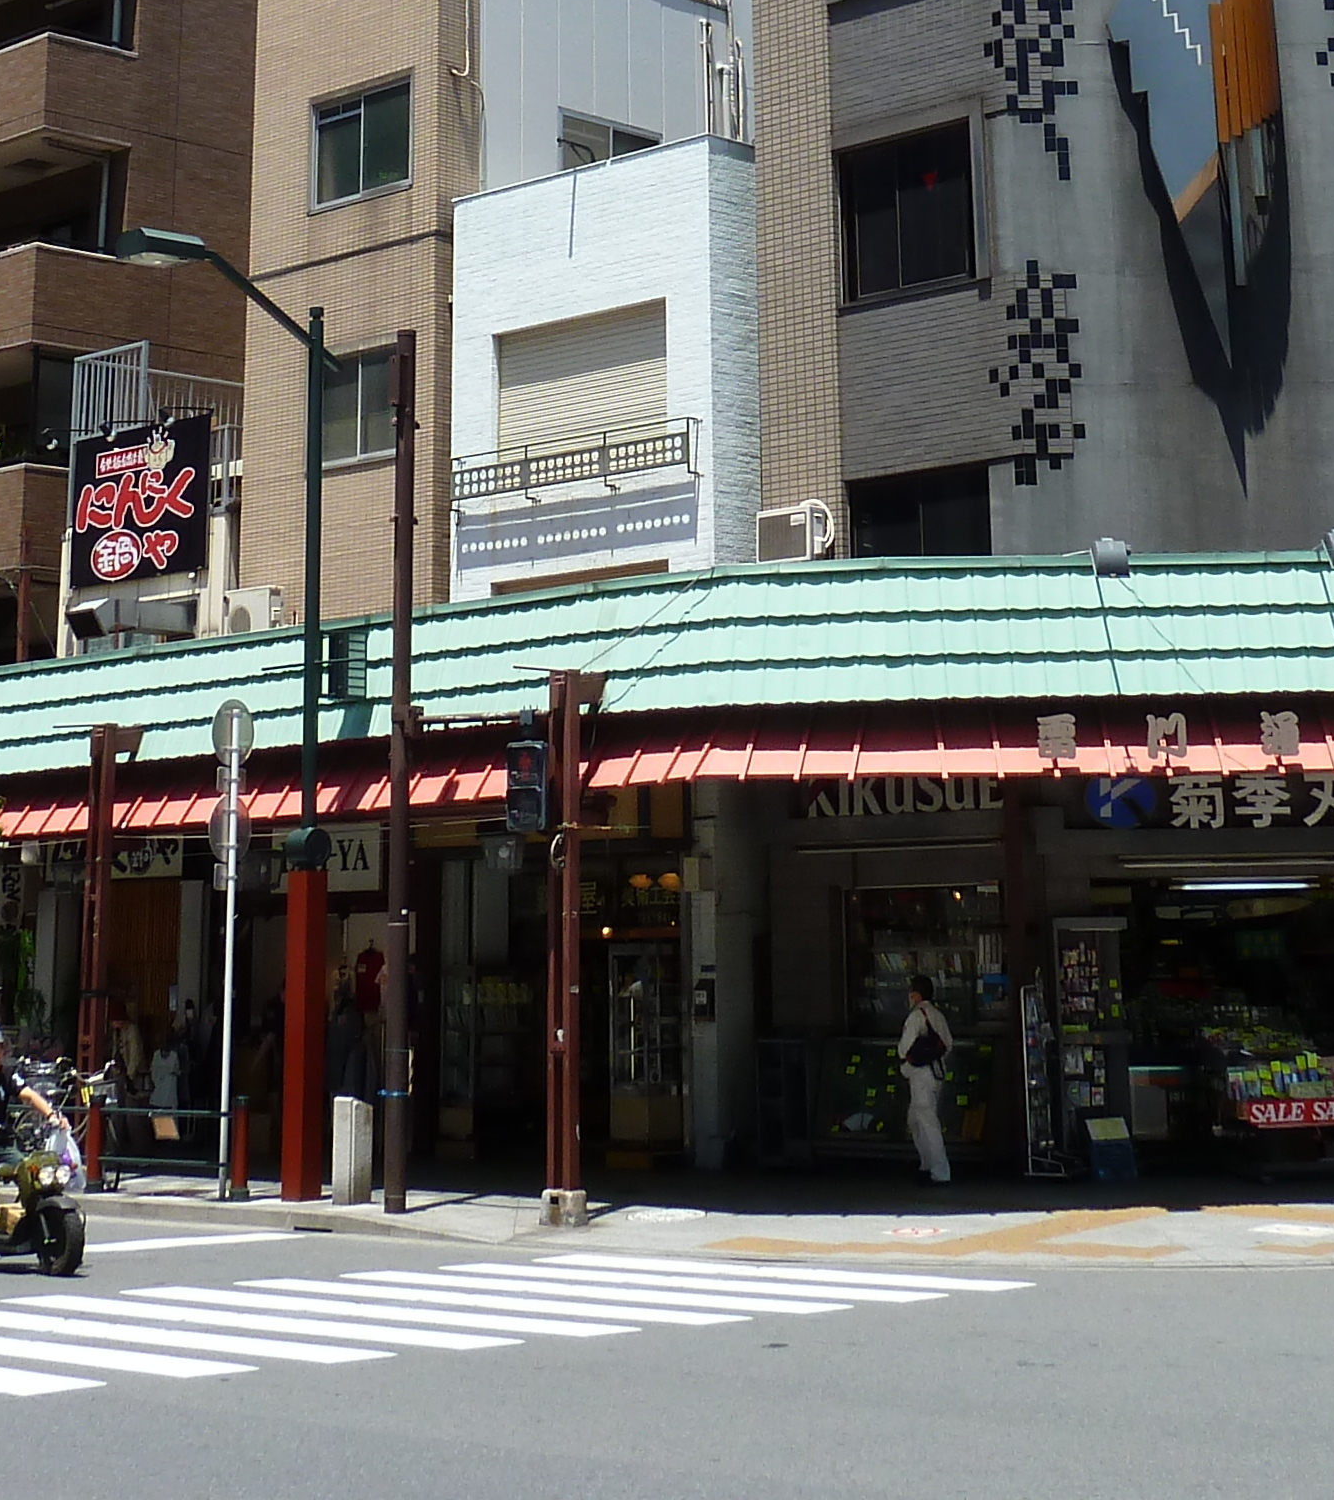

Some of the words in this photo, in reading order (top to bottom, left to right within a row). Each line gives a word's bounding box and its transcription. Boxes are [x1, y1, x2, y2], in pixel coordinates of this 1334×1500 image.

[75, 466, 196, 534] にんにく
[95, 530, 180, 573] 鍋や
[807, 776, 1004, 818] KIKUSUE
[1249, 1102, 1306, 1125] SALE
